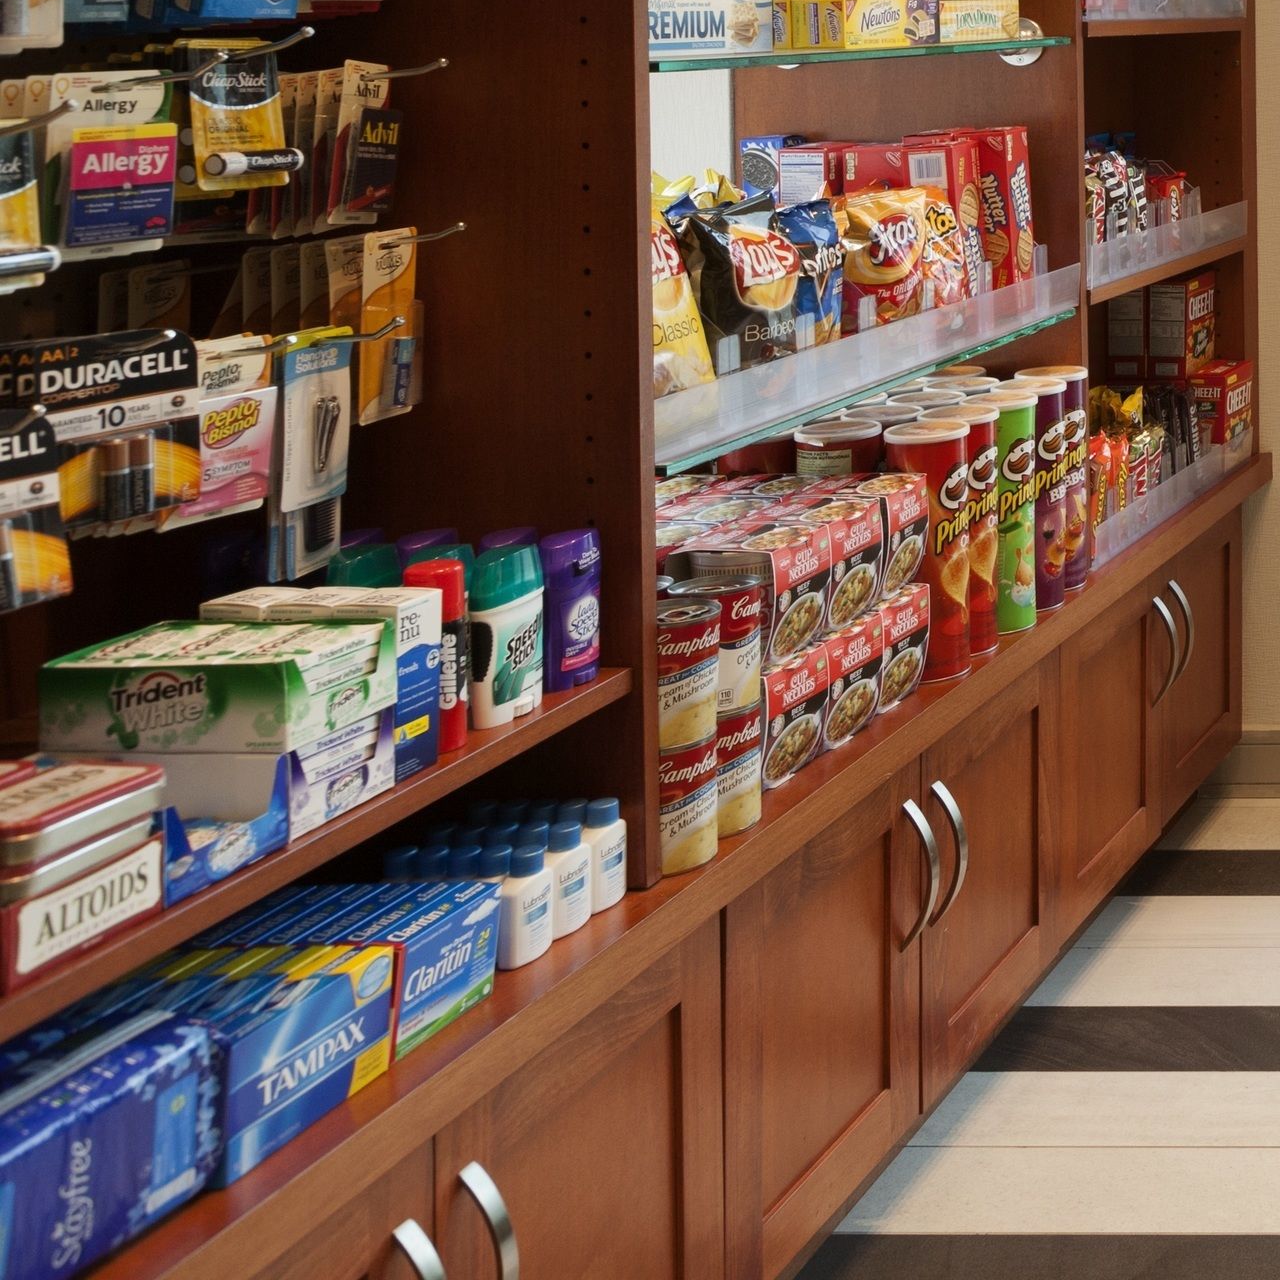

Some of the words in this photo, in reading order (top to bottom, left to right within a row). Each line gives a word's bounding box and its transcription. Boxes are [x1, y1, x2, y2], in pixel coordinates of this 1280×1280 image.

[648, 9, 726, 40] REMIUM
[825, 7, 839, 43] Newtons
[860, 5, 901, 32] Newtons
[202, 71, 268, 89] ChapStick
[354, 83, 380, 99] Advil
[82, 98, 138, 114] Allergy
[360, 121, 399, 145] Advil
[82, 151, 169, 176] Allergy
[981, 173, 1006, 225] Nutter
[1010, 171, 1028, 231] Butter
[1016, 161, 1033, 223] Nutter
[652, 231, 680, 285] ay's
[742, 233, 795, 288] Lay's
[877, 288, 890, 298] The
[1188, 288, 1215, 321] CHEEZ-IT
[652, 317, 700, 347] Classic
[40, 349, 189, 395] DURACELL
[201, 363, 243, 387] Pepto-
[295, 356, 337, 373] Solutions
[1194, 385, 1221, 400] HEEZ-IT
[1226, 381, 1252, 416] CHEEZ-IT
[98, 405, 126, 430] 10
[202, 399, 262, 431] Pepto-
[206, 412, 260, 445] Bismol
[795, 547, 813, 565] CUP
[569, 609, 599, 634] Speed
[577, 598, 597, 617] Lady
[896, 607, 914, 624] CUP
[505, 618, 538, 662] SPEED
[576, 623, 599, 642] Stick
[657, 623, 720, 658] Campbell
[848, 635, 866, 654] CUP
[512, 638, 536, 671] STICK
[439, 632, 458, 710] Gillette
[790, 669, 809, 689] CUP
[112, 671, 207, 712] Trident
[327, 684, 363, 713] Trident
[672, 677, 714, 705] Mushroom
[782, 677, 816, 707] NOODLES
[123, 700, 206, 734] White
[791, 701, 807, 716] BEEF
[35, 861, 149, 947] ALTOIDS
[386, 909, 442, 943] Claritin
[403, 937, 473, 1003] Claritin
[256, 1017, 366, 1108] TAMPAX
[52, 1136, 94, 1270] Stayfree
